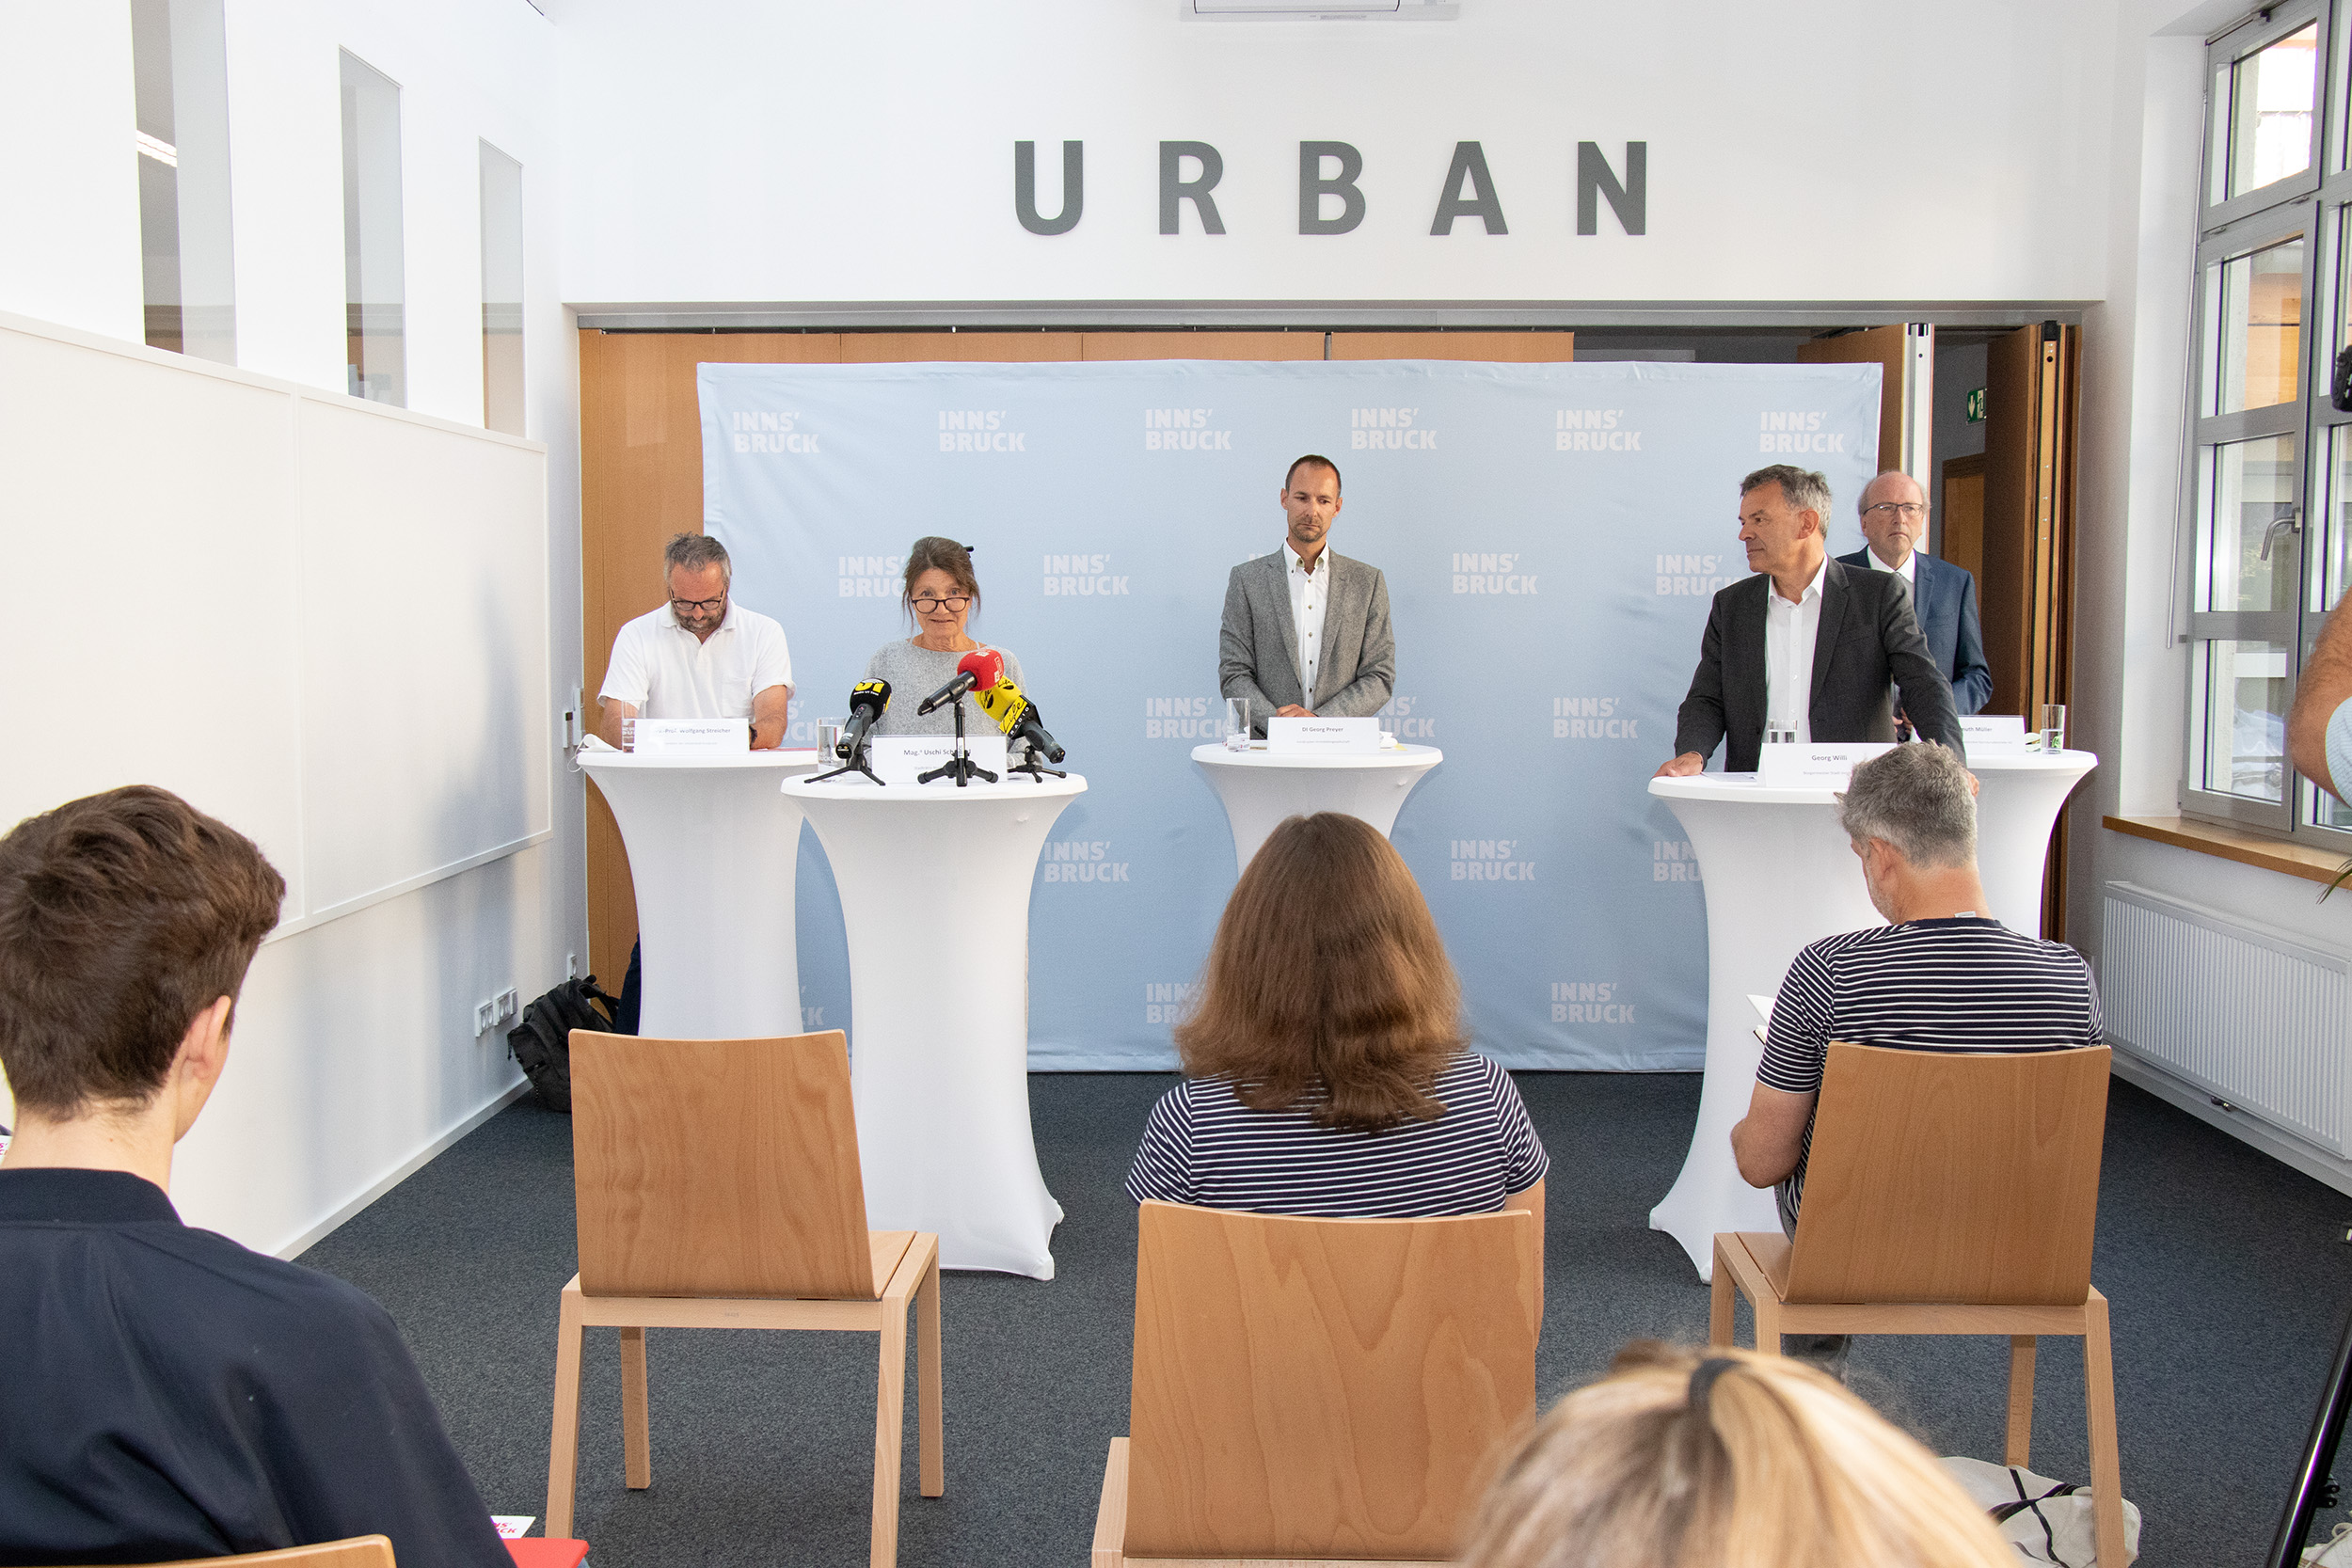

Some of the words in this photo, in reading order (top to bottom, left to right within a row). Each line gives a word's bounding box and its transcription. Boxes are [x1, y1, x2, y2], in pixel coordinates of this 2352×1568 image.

[1014, 139, 1647, 237] URBAN
[734, 433, 820, 453] BRUCK
[939, 432, 1025, 451] BRUCK
[1146, 430, 1232, 451] BRUCK
[1351, 429, 1437, 450] BRUCK
[1556, 431, 1642, 451] BRUCK
[1760, 433, 1844, 453] BRUCK
[838, 578, 906, 597] BRUC
[1043, 576, 1130, 596] BRUCK
[1453, 575, 1539, 595] BRUCK
[1009, 706, 1030, 736] RADIO
[1553, 718, 1639, 739] BRUCK
[1653, 840, 1697, 862] INN
[1043, 862, 1131, 883] BRUCK
[1450, 861, 1536, 882] BRUCK
[1653, 862, 1703, 882] BRU
[1550, 1004, 1637, 1025] BRUCK
